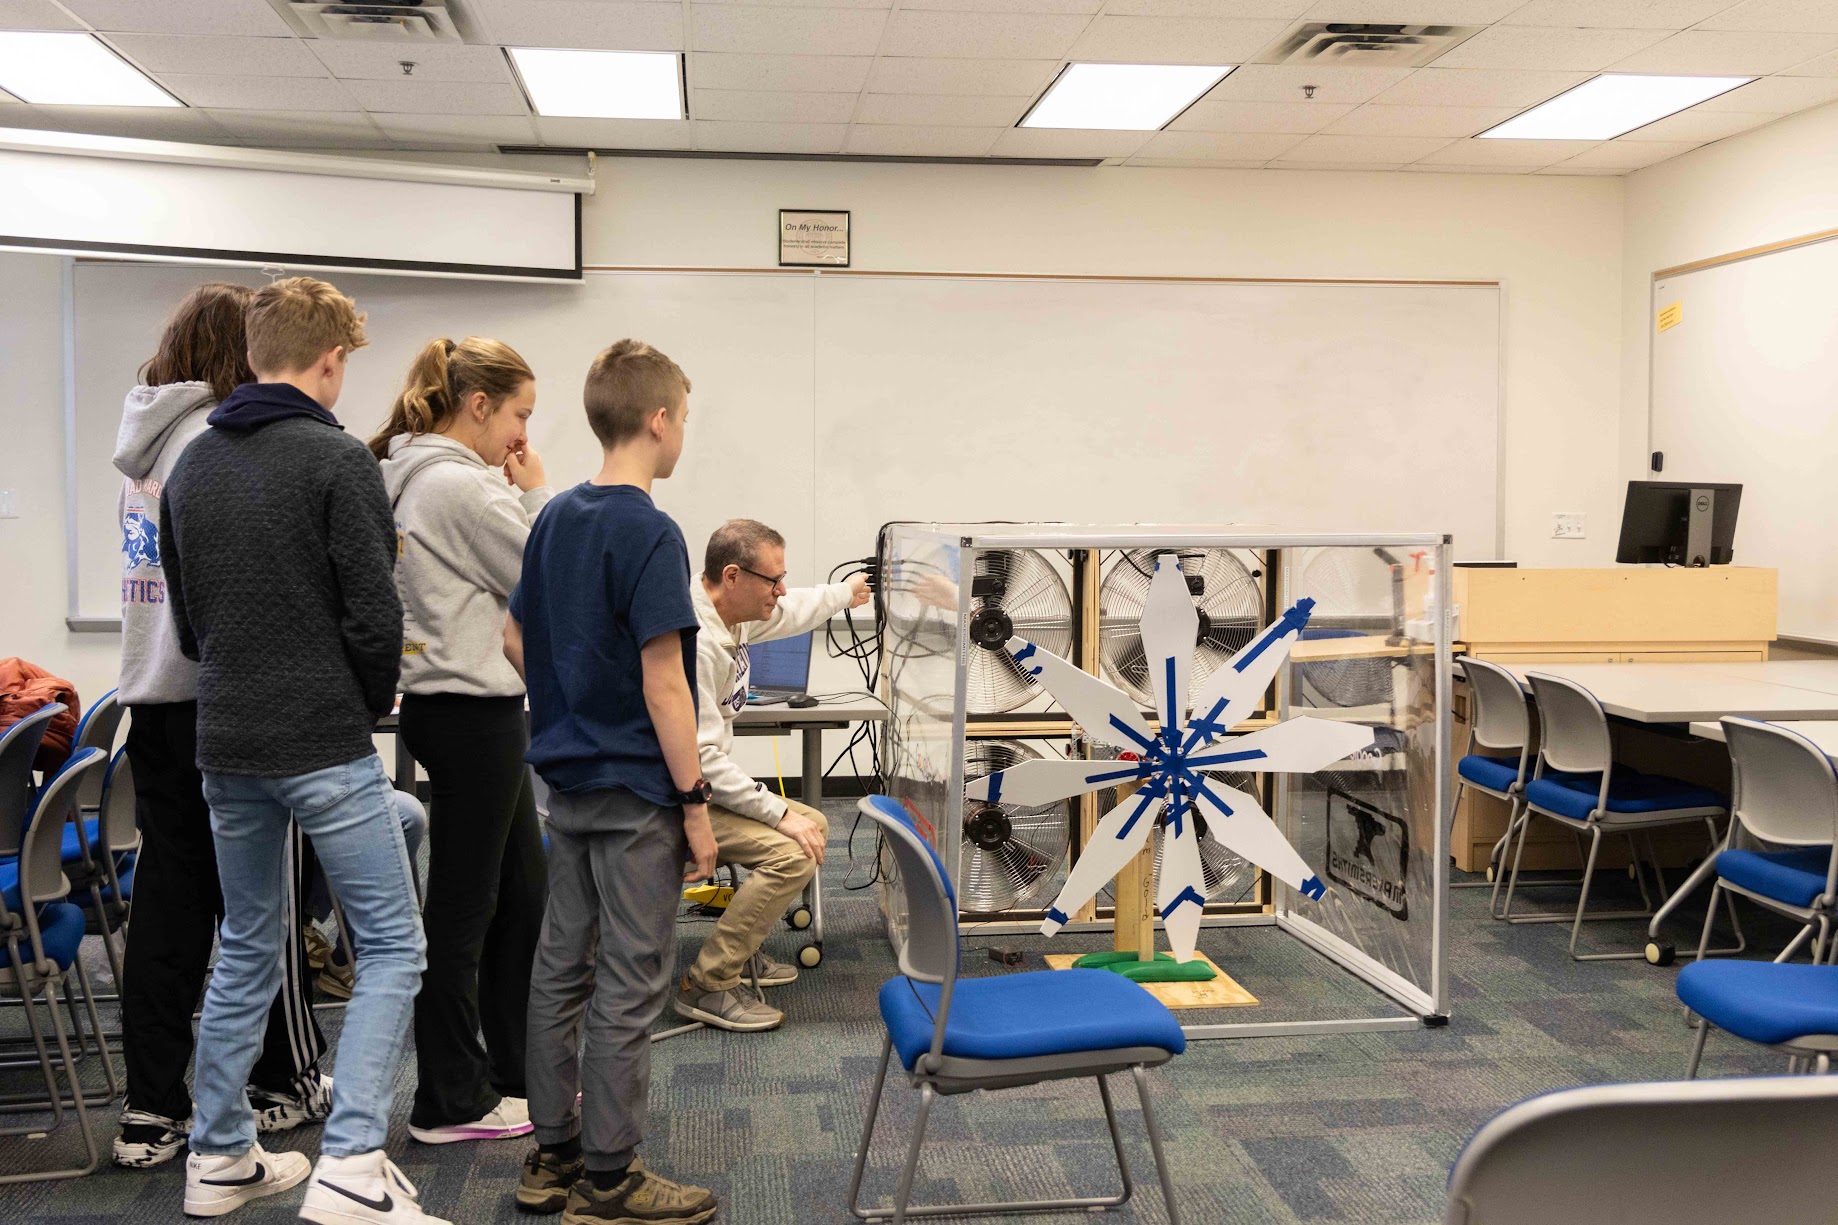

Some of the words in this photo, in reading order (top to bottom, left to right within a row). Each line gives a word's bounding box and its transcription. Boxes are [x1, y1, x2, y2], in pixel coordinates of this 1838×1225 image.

[785, 223, 797, 231] On
[799, 224, 811, 232] My
[813, 224, 844, 232] Honor...
